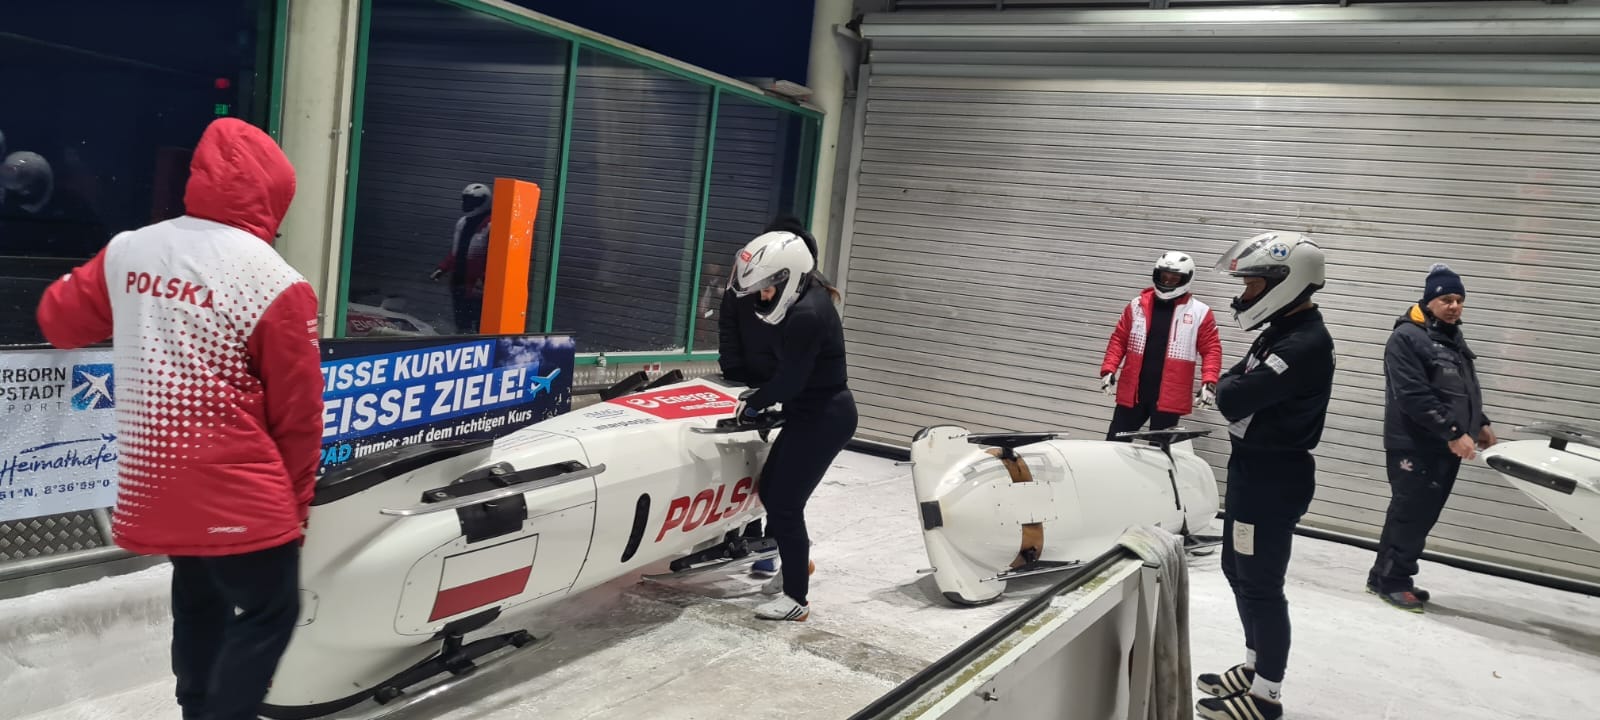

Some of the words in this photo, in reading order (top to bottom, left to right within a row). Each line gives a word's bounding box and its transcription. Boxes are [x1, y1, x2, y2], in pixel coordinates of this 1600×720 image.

[126, 271, 214, 308] POLSKA
[0, 367, 66, 383] RBORN
[320, 358, 388, 392] ISSE
[393, 344, 490, 381] KURVEN
[321, 385, 425, 438] EISSE
[430, 367, 526, 415] ZIELE!
[354, 438, 400, 459] immer
[402, 431, 424, 446] auf
[425, 426, 453, 442] dem
[455, 414, 506, 436] richtigen
[507, 409, 532, 424] Kurs
